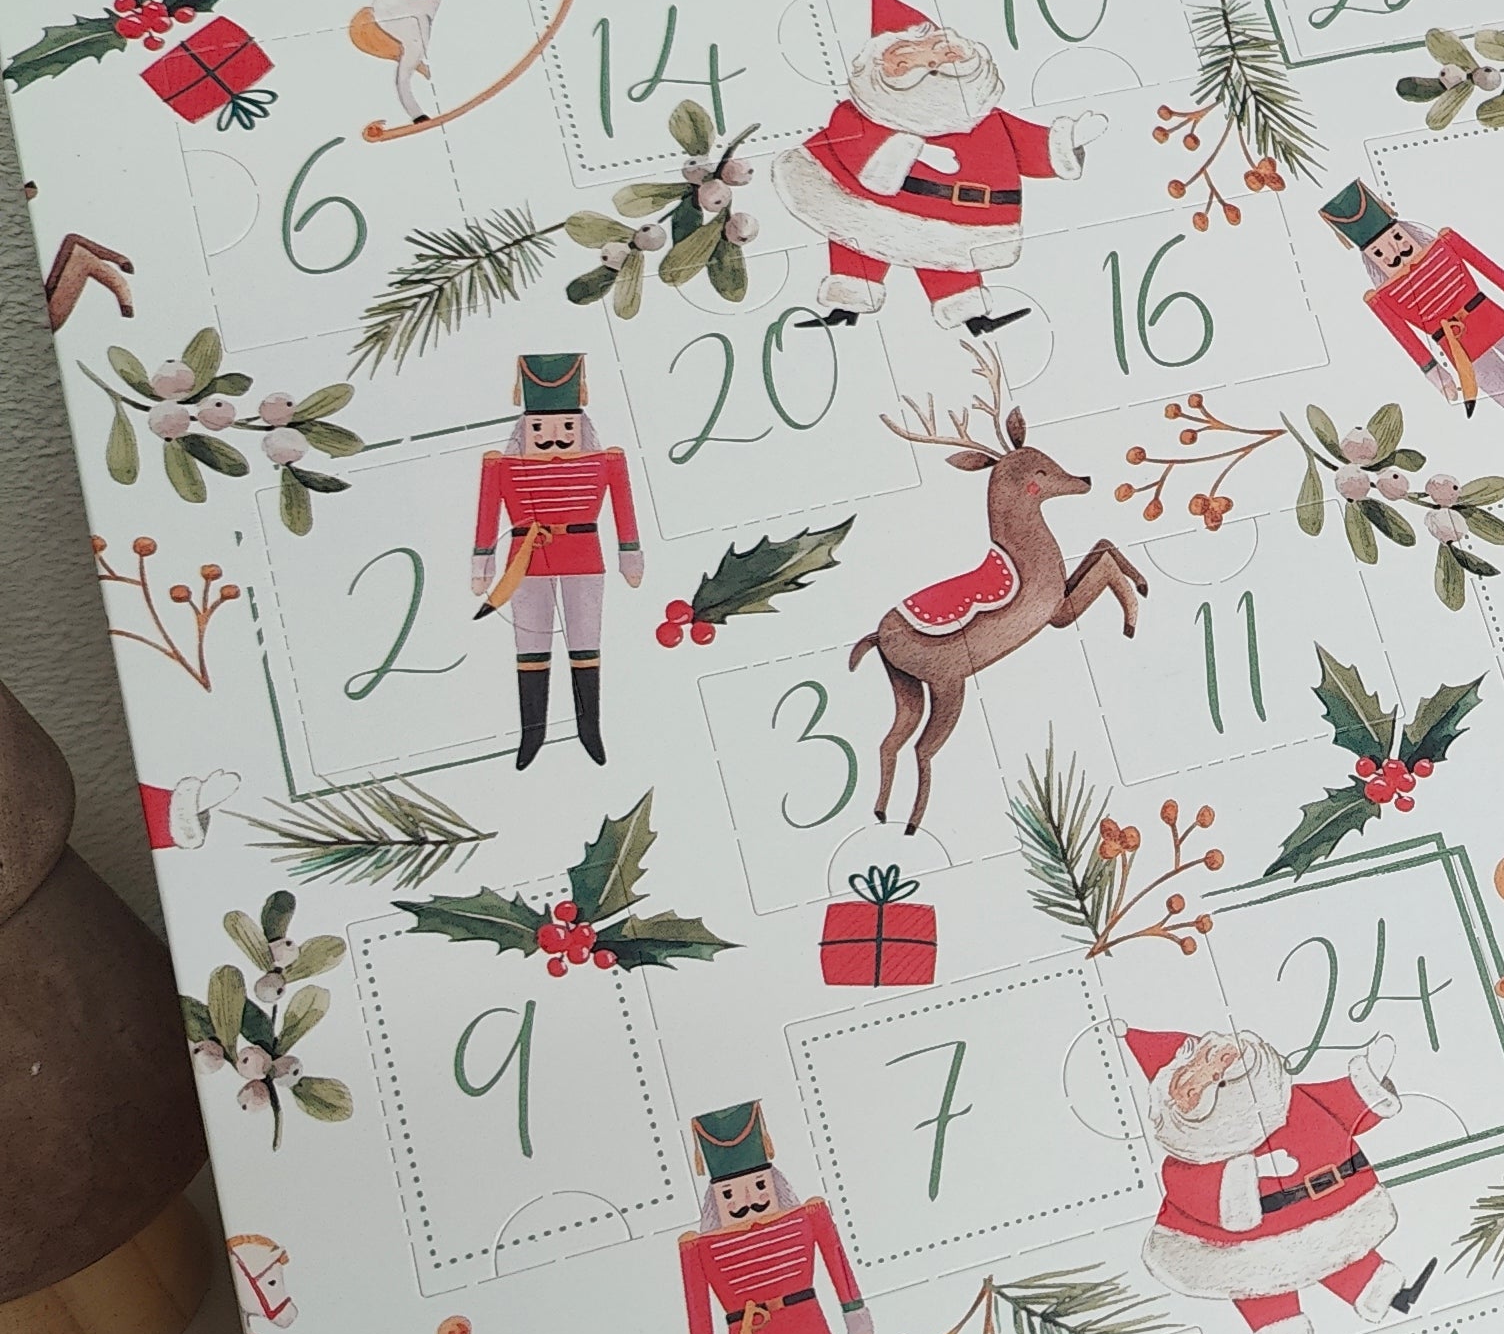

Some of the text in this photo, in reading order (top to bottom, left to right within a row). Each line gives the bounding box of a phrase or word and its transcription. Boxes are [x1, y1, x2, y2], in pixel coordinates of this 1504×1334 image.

[592, 5, 747, 138] 14
[281, 136, 367, 275] 6
[1102, 233, 1214, 375] 16
[668, 306, 839, 465] 20
[344, 547, 468, 701] 2
[1194, 591, 1267, 734] 11
[772, 680, 858, 830] 3
[1276, 918, 1453, 1075] 24
[454, 999, 537, 1159] 9
[885, 1040, 974, 1202] 7
